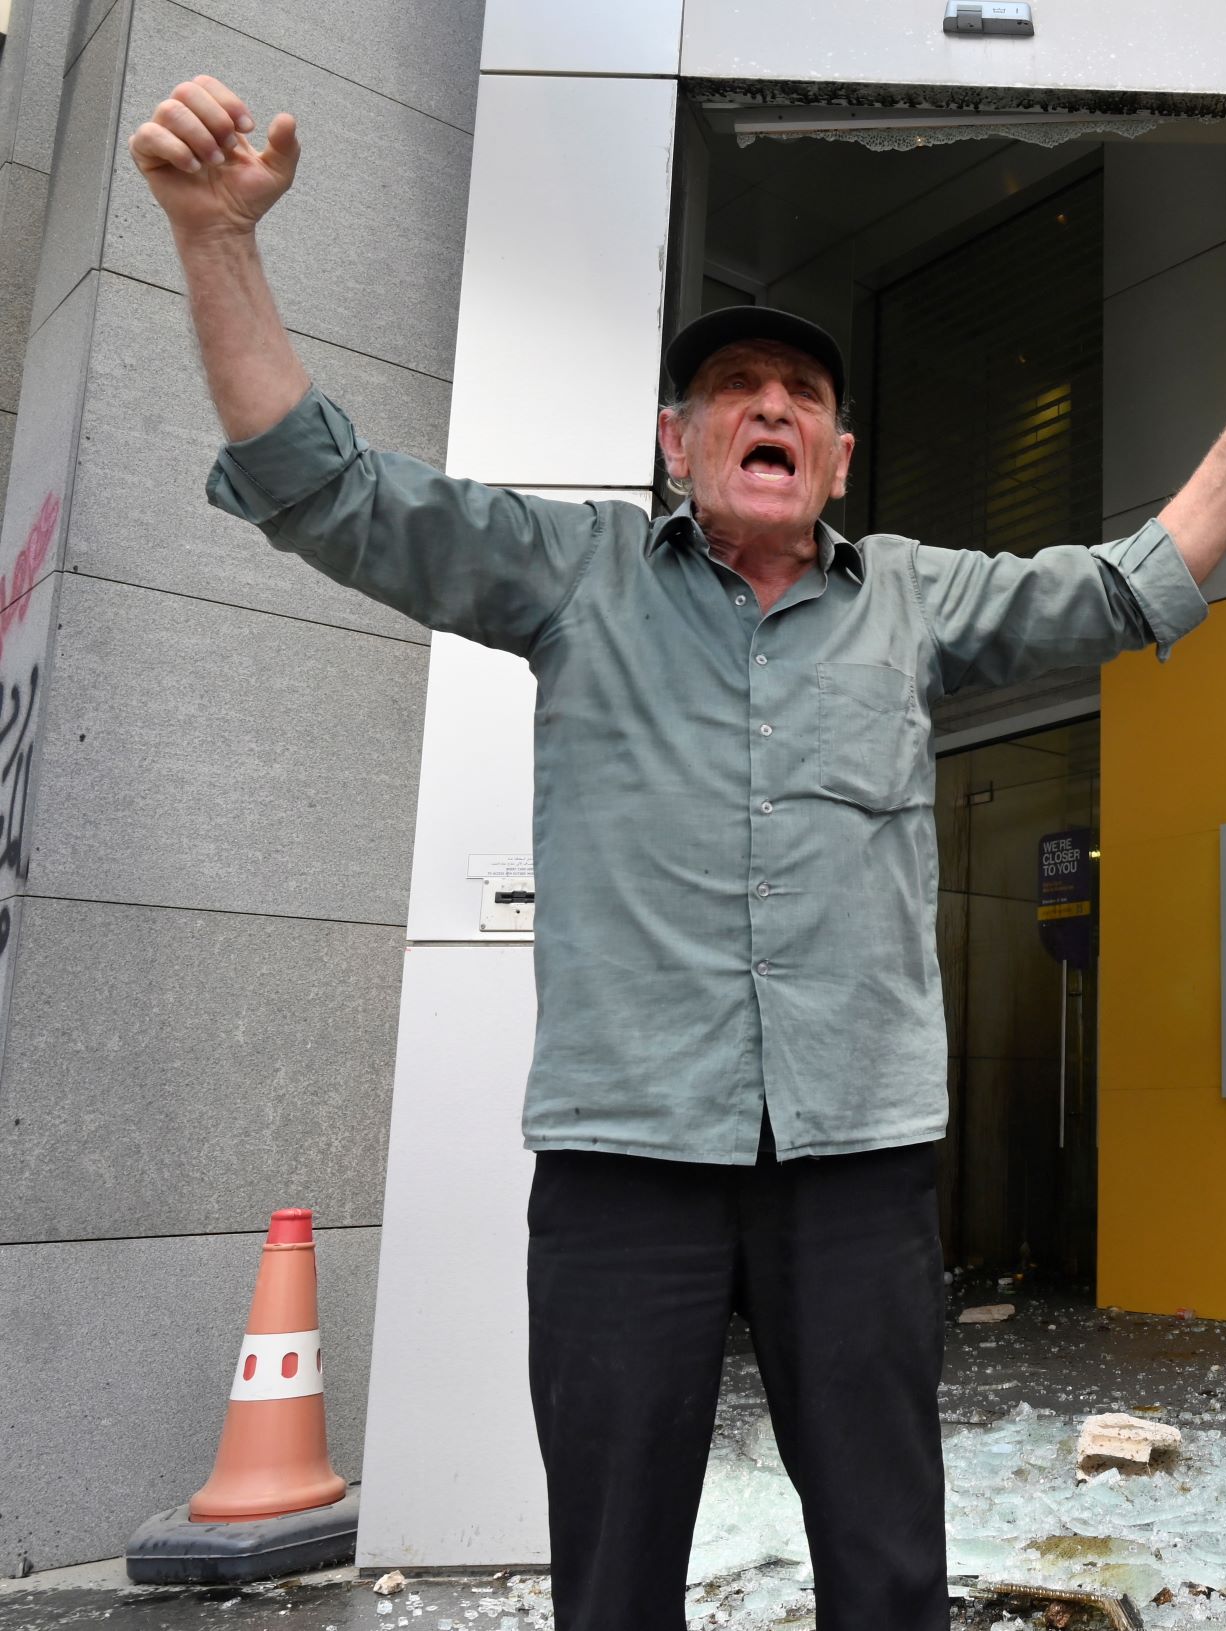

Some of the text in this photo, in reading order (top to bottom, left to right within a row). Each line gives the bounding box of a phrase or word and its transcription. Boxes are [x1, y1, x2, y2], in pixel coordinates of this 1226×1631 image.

[1042, 849, 1080, 865] CLOSER
[1042, 861, 1077, 877] TO YOU
